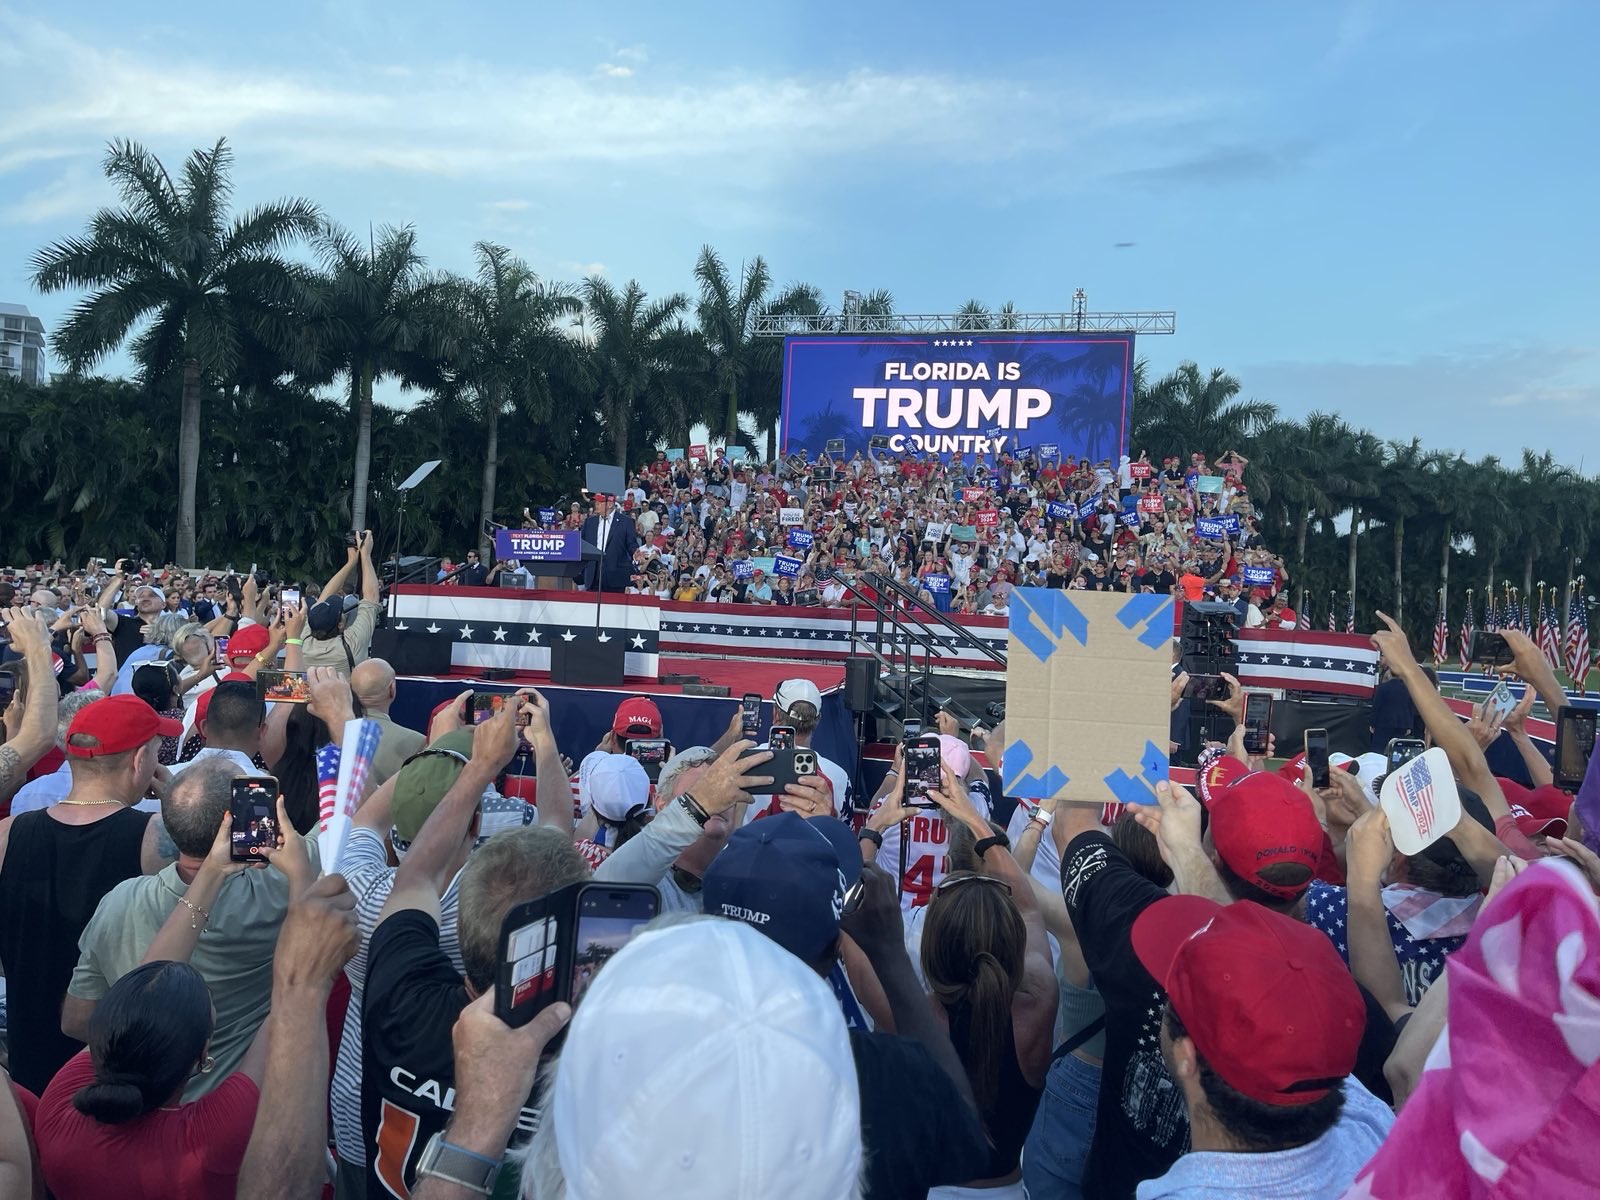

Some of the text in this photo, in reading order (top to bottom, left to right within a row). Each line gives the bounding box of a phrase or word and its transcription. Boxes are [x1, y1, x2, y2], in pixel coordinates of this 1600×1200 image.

[885, 362, 1021, 381] FLORIDA IS
[853, 387, 1052, 430] TRUMP
[1052, 504, 1072, 514] TRUMP
[1053, 508, 1068, 517] 2024
[1200, 521, 1223, 529] TRUMP
[792, 531, 813, 540] TRUMP
[511, 539, 565, 551] TRUMP
[778, 560, 799, 569] TRUMP
[628, 715, 652, 725] MAGA
[1403, 771, 1427, 834] TRUMP 2024
[1256, 845, 1297, 860] DONALD
[721, 903, 771, 925] TRUMP
